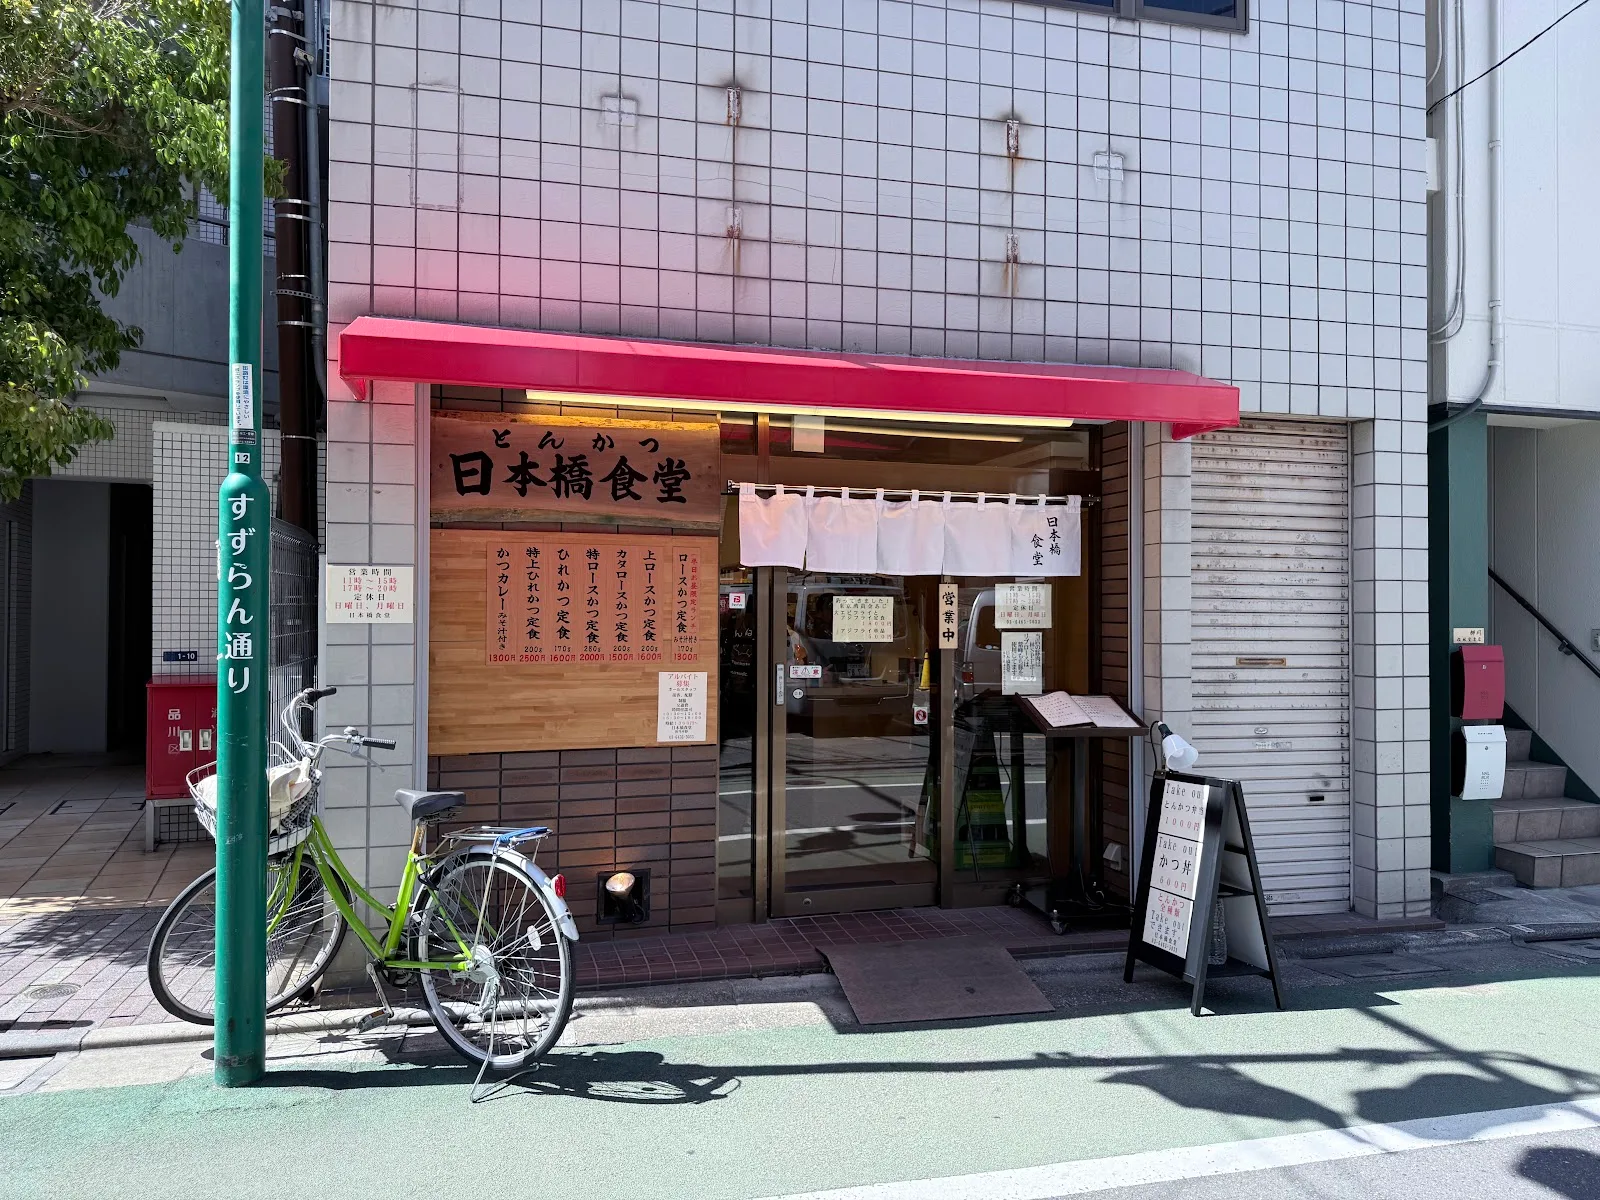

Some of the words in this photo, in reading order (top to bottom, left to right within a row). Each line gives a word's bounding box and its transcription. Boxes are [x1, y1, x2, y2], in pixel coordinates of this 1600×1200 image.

[236, 454, 249, 462] 12
[492, 428, 659, 453] とんかつ
[449, 450, 692, 504] 日本橋食堂
[1031, 533, 1044, 566] 食堂
[1046, 516, 1061, 556] 日本橋
[225, 493, 256, 694] すずらん通り
[348, 568, 392, 576] 営業時間
[353, 593, 385, 601] 定休日
[525, 546, 541, 640] 特上ひれかつ定食
[556, 548, 571, 640] ひれかつ定食
[585, 547, 600, 644] 特ロースかつ定食
[614, 549, 628, 643] カタロースかつ定食
[643, 549, 657, 642] 上ロースかつ定食
[676, 553, 688, 634] ロースかつ定食
[942, 591, 956, 642] 営業中
[177, 652, 196, 660] 1-10
